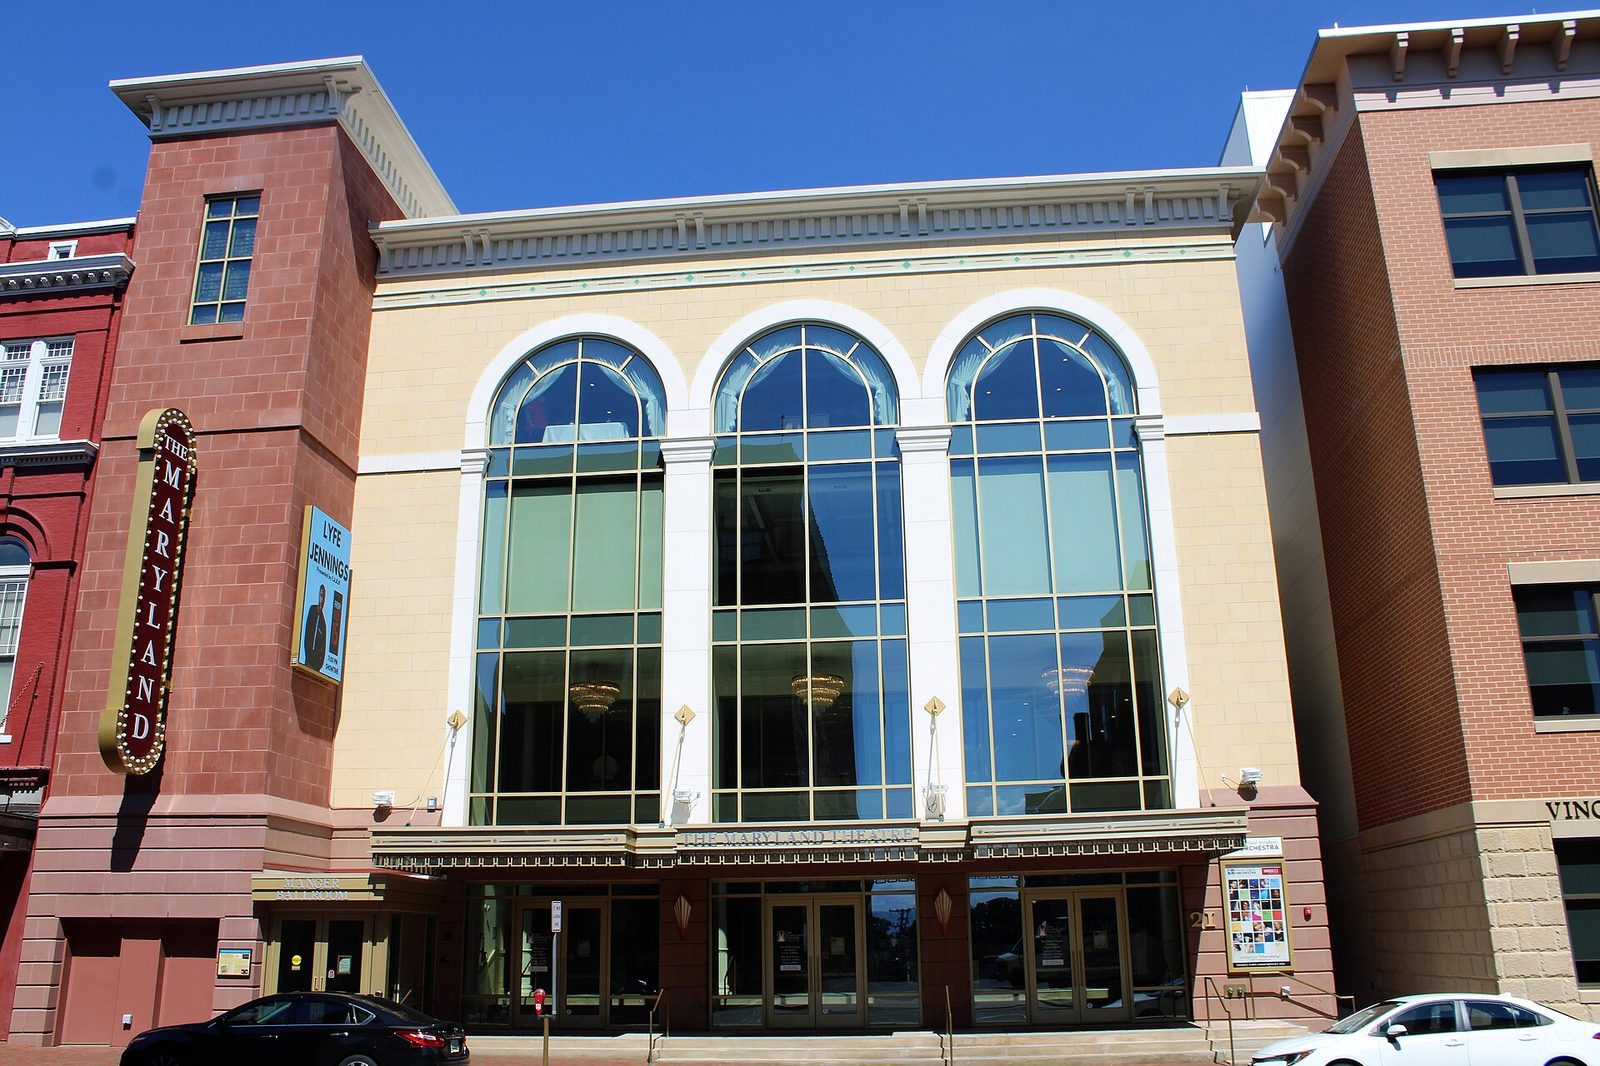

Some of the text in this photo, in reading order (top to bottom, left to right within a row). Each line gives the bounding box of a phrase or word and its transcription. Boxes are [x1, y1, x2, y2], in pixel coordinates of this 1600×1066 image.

[164, 433, 189, 462] THE
[323, 520, 342, 548] LYFE
[310, 542, 349, 581] JENNINGS
[131, 459, 182, 739] MARYLAND
[681, 827, 913, 847] THE MARYLAND THEATRE
[275, 890, 349, 901] BALLROOM
[1190, 911, 1216, 929] 21
